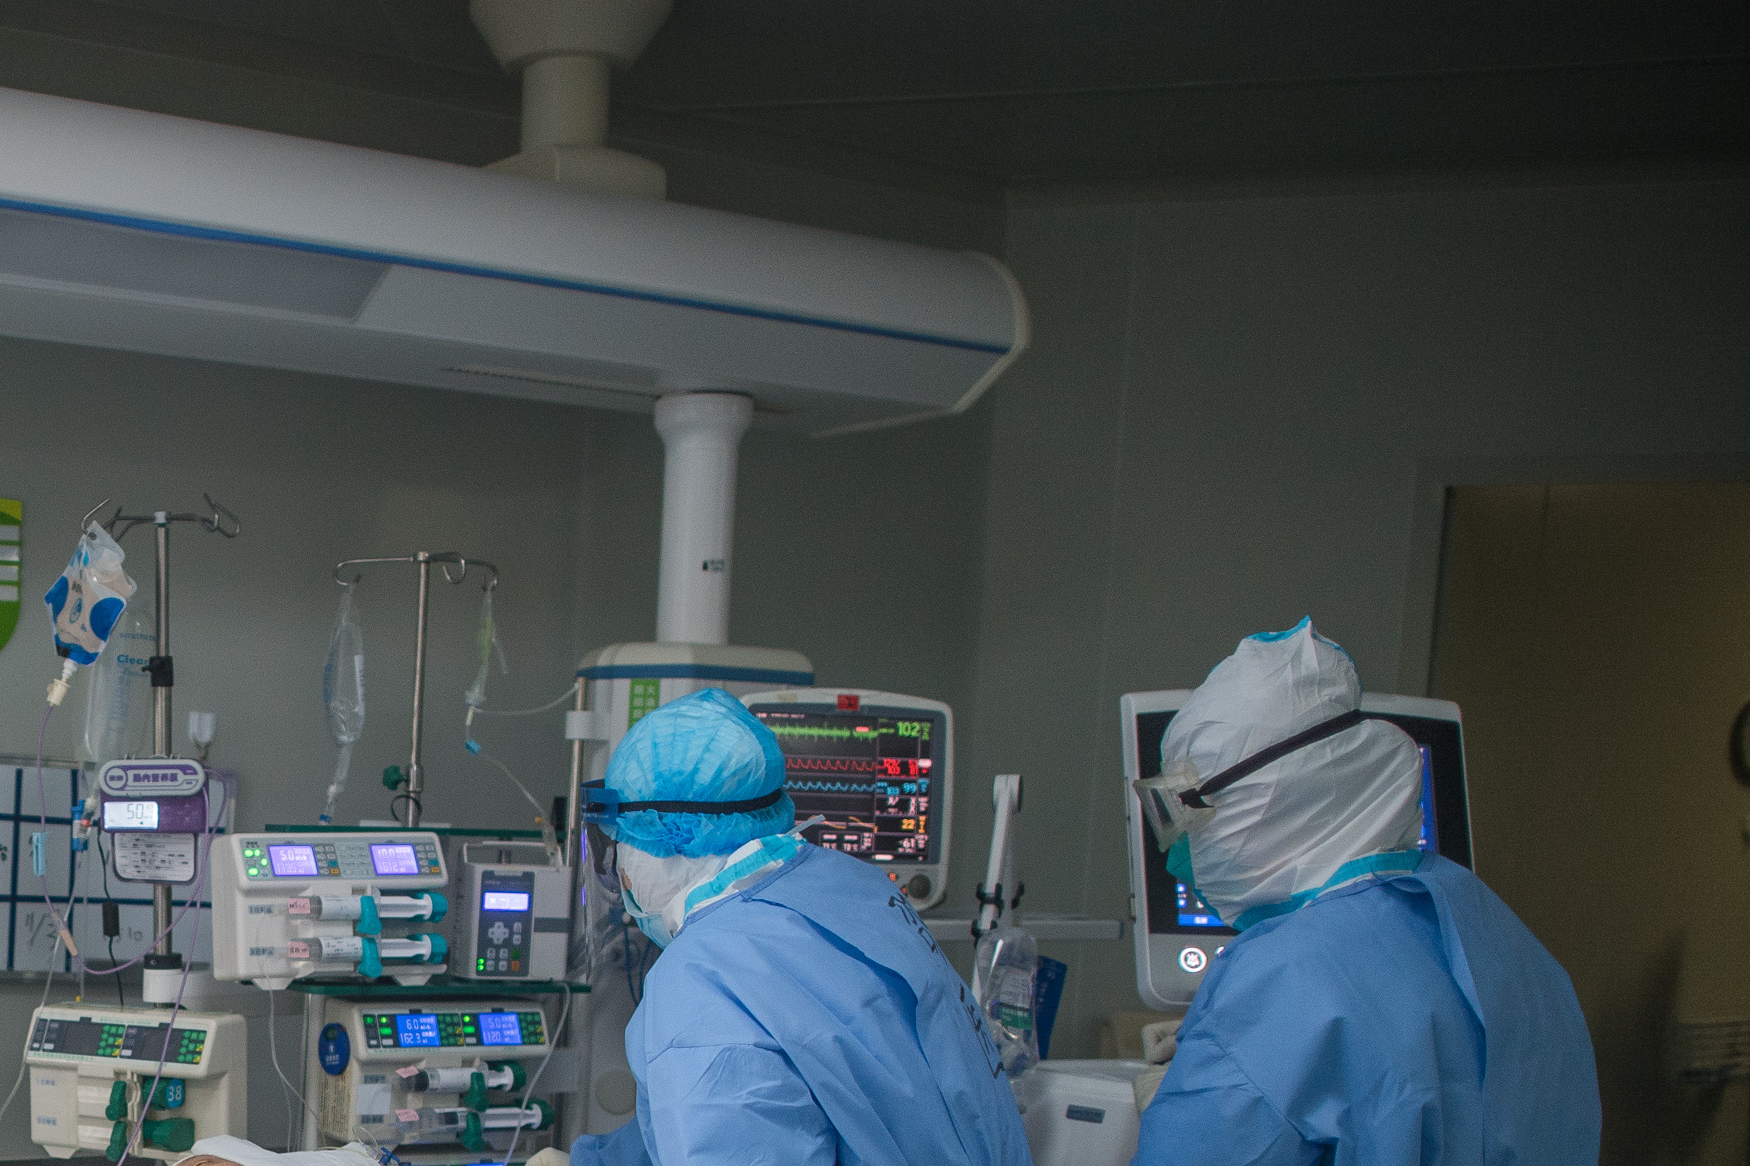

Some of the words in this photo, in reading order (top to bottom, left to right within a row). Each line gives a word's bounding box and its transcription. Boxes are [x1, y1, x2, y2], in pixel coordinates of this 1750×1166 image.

[896, 721, 920, 737] 102
[902, 782, 917, 794] 99
[126, 803, 145, 820] 50
[902, 818, 915, 830] 22
[167, 1085, 182, 1102] 38
